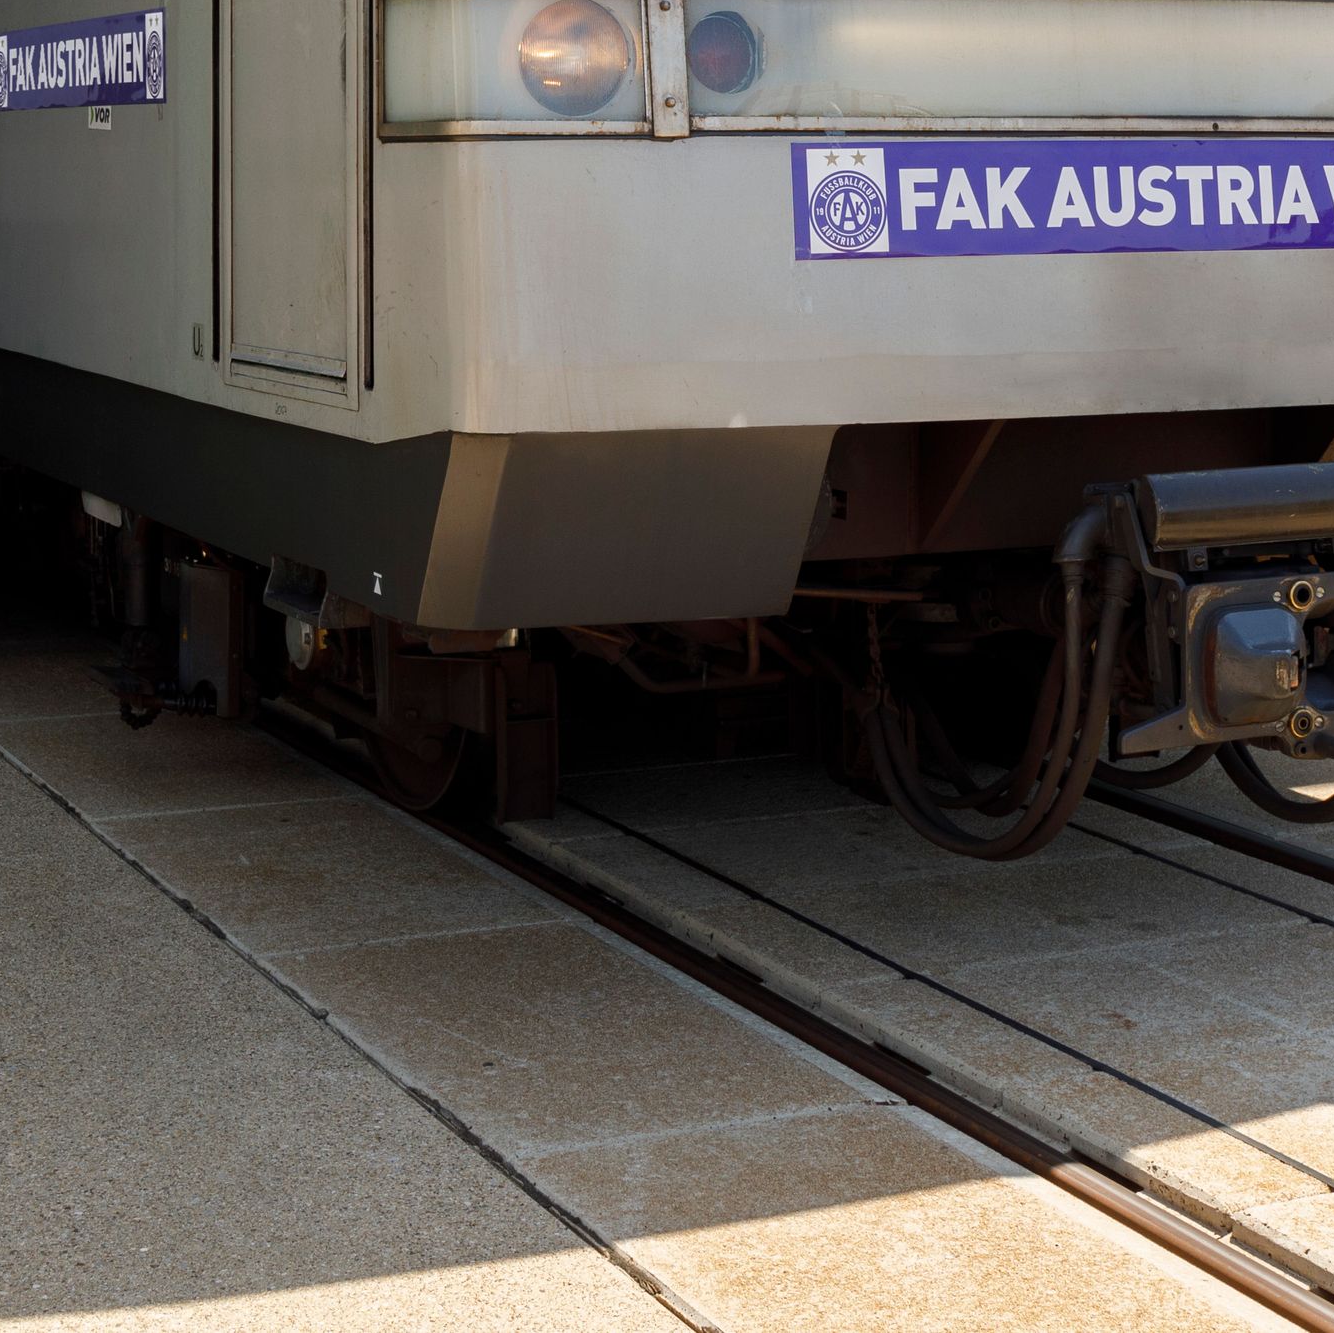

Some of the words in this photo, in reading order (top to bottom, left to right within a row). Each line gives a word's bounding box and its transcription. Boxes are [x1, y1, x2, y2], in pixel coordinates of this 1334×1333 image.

[9, 45, 36, 93] FAK
[37, 36, 102, 90] AUSTRIA
[102, 31, 144, 84] WIEN
[94, 107, 110, 123] VOR
[820, 176, 877, 201] FUSSBALLKLUB
[898, 166, 1035, 231] FAK
[1046, 165, 1320, 229] AUSTRIA
[821, 225, 855, 246] AUSTRIA
[857, 224, 877, 244] WIEN
